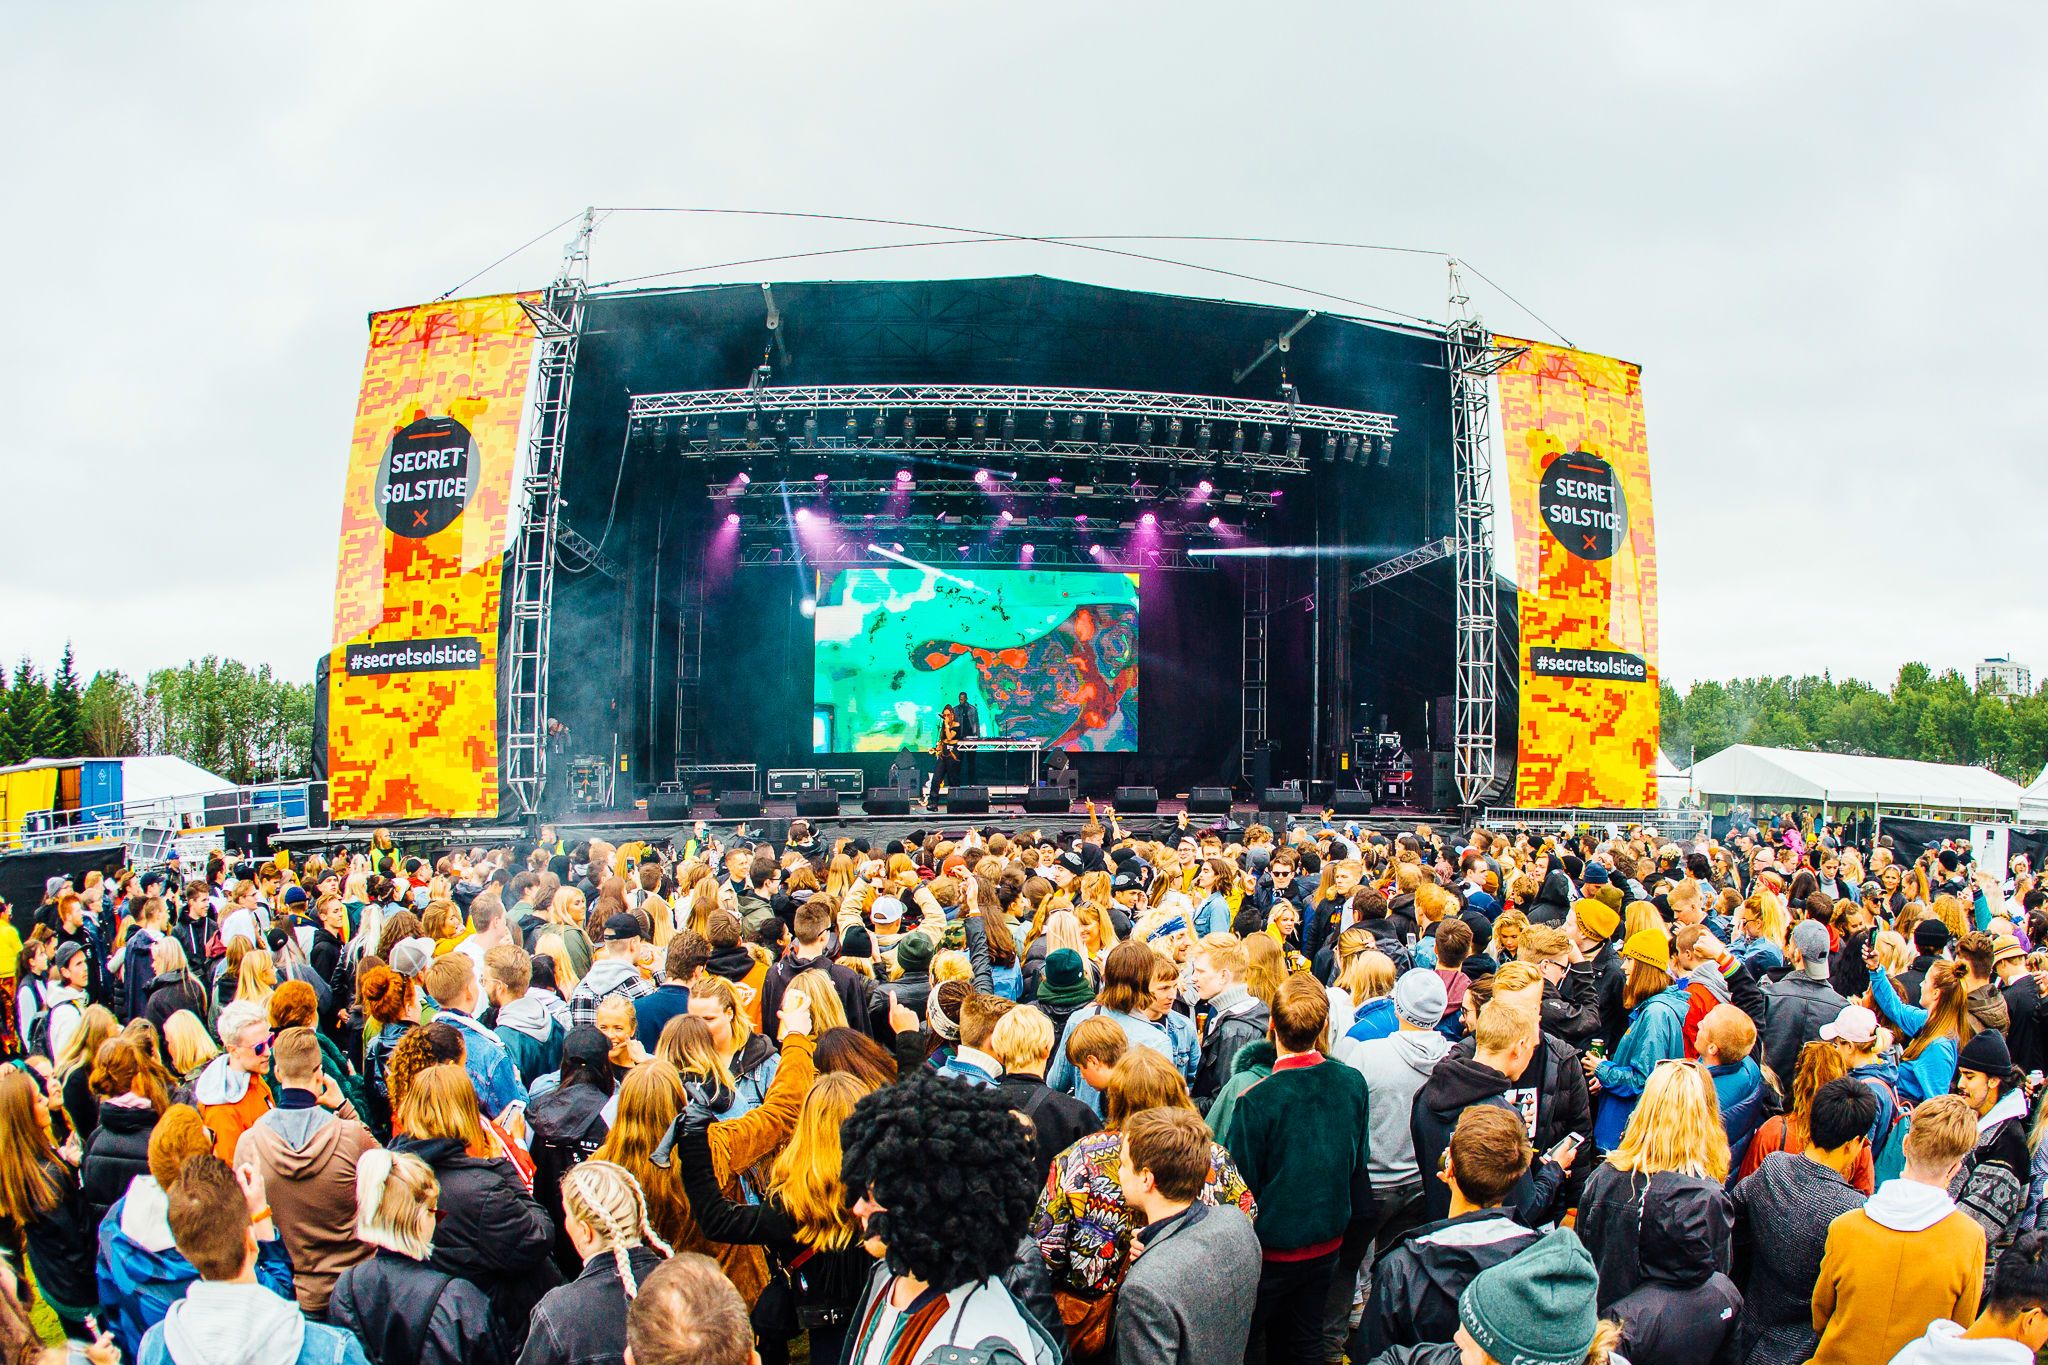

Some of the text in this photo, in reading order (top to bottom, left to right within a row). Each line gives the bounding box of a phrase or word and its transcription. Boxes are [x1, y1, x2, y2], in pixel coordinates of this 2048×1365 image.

[391, 448, 464, 473] SECRET
[1556, 478, 1615, 504] SECRET
[350, 645, 477, 669] #secretsolstice
[1537, 655, 1644, 676] #secretsolstice
